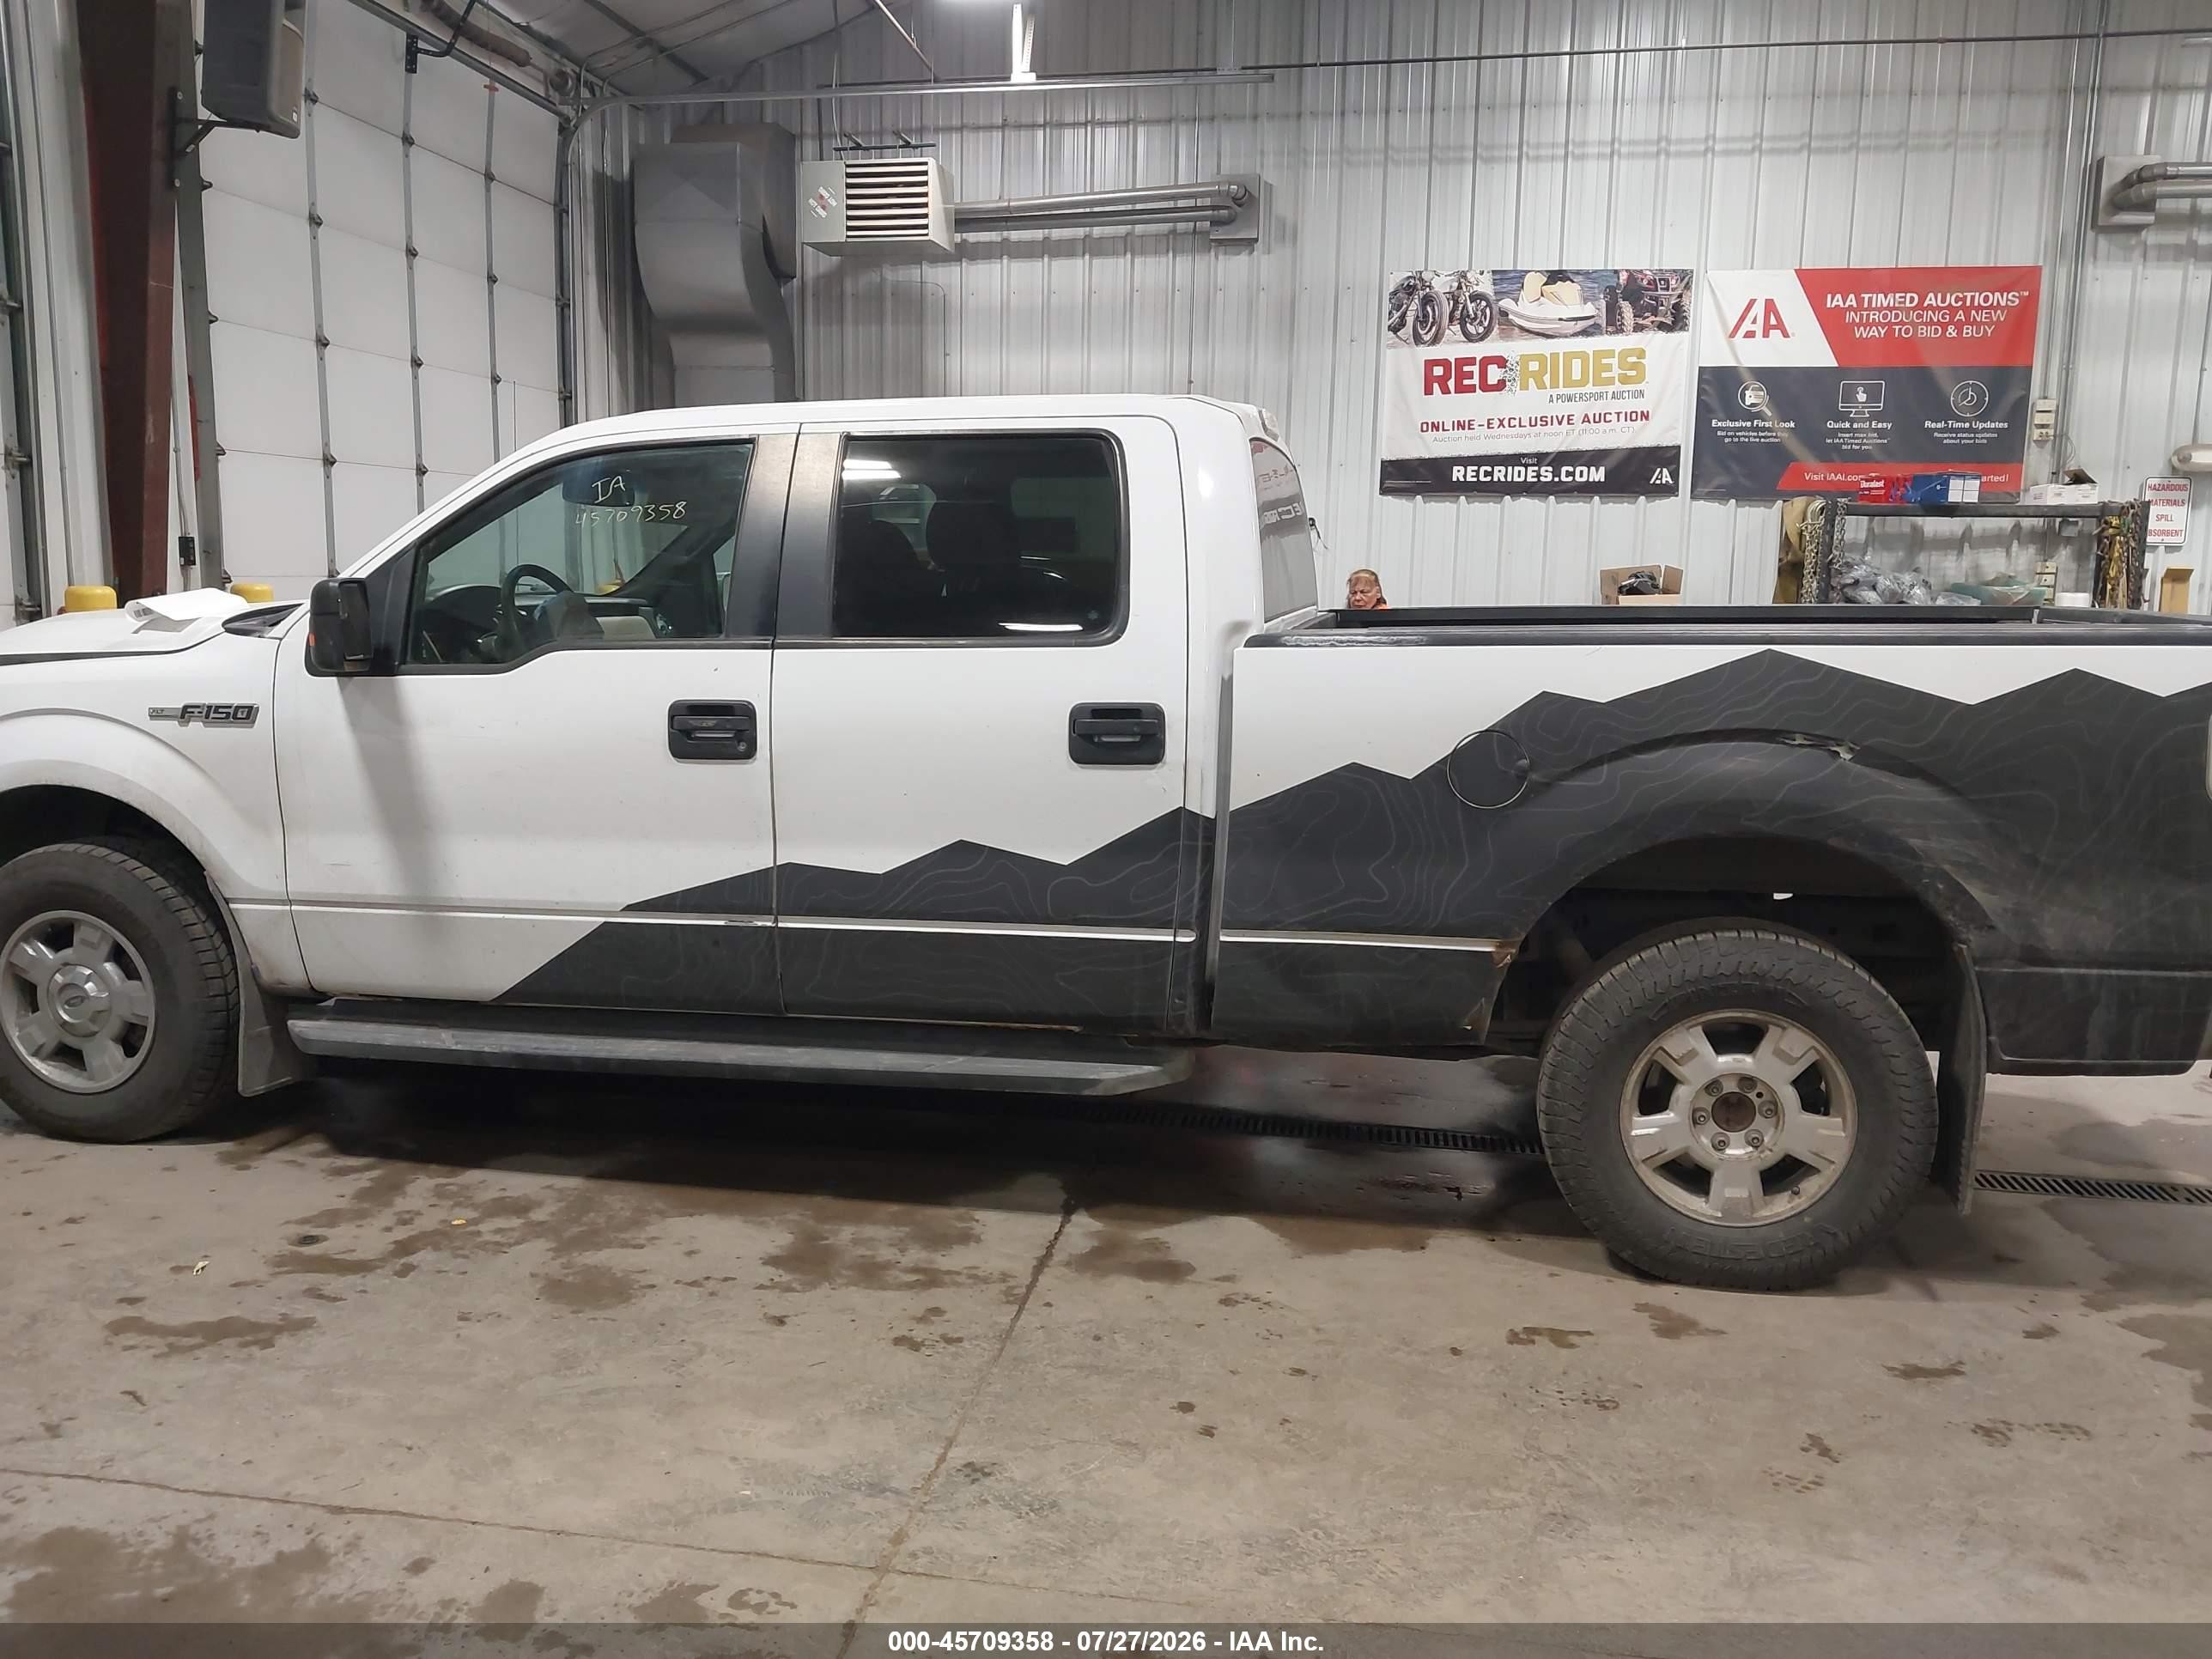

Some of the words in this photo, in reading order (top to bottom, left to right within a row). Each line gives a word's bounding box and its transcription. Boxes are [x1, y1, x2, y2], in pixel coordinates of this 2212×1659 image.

[1826, 293, 1857, 308] IAA
[1861, 293, 1918, 308] TIMED
[1845, 310, 1950, 324] INTRODUCING
[1954, 310, 1966, 322] A
[1971, 309, 2008, 322] NEW
[1855, 325, 1888, 338] WAY
[1893, 325, 1912, 337] TO
[1917, 325, 1942, 337] BID
[1946, 325, 1958, 337] &
[1963, 325, 1996, 337] BUY
[1423, 355, 1507, 396] REC
[1519, 347, 1647, 392] RIDES
[1548, 394, 1554, 404] A
[1556, 391, 1609, 404] POWERSPORT
[1611, 389, 1645, 400] AUCTION
[1419, 414, 1575, 433] ONLINE-EXCLUSIVE
[1581, 410, 1650, 424] AUCTION
[1711, 419, 1752, 428] Exclusive
[1753, 419, 1772, 428] First
[1774, 420, 1796, 428] Look
[1826, 420, 1851, 428] Quick
[1872, 420, 1893, 429] Easy
[1924, 420, 1970, 428] Real-Time
[1972, 420, 2008, 429] Updates
[1464, 433, 1480, 441] held
[1483, 431, 1532, 441] Wednesdays
[1451, 465, 1606, 483] RECRIDES.COM
[1804, 472, 1824, 481] Visit
[1981, 473, 2009, 482] arted!
[2147, 483, 2189, 492] HAZARDOUS
[574, 501, 688, 528] 45709358
[2155, 514, 2174, 522] SPILL
[2148, 528, 2184, 538] BSORBENT
[179, 704, 258, 721] F-150
